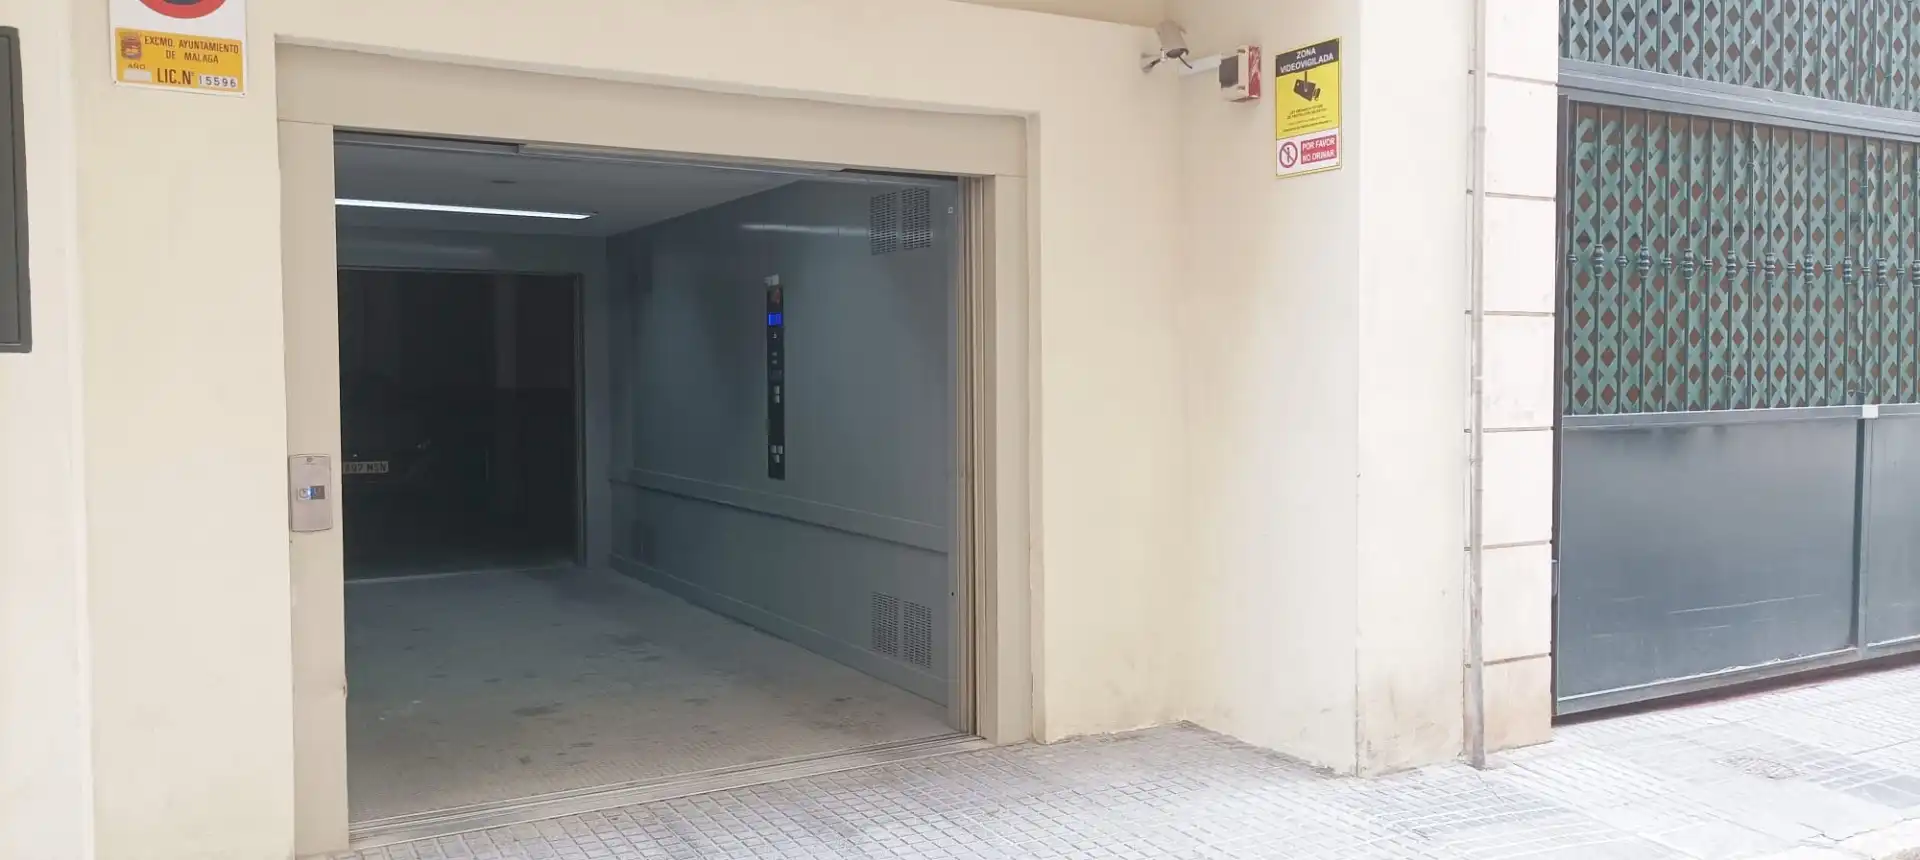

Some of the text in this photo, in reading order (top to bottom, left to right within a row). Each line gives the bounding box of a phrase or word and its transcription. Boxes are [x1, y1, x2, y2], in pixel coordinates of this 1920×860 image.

[144, 35, 239, 54] EXCMO. AYUNTAMIENTO
[165, 49, 219, 64] DE MALAGA
[1295, 47, 1317, 60] ZONA
[1279, 52, 1334, 74] VIDEOVIGILADA
[199, 75, 237, 88] 15596
[1302, 137, 1335, 152] POR FAVOR
[1302, 149, 1335, 163] NO ORINAR
